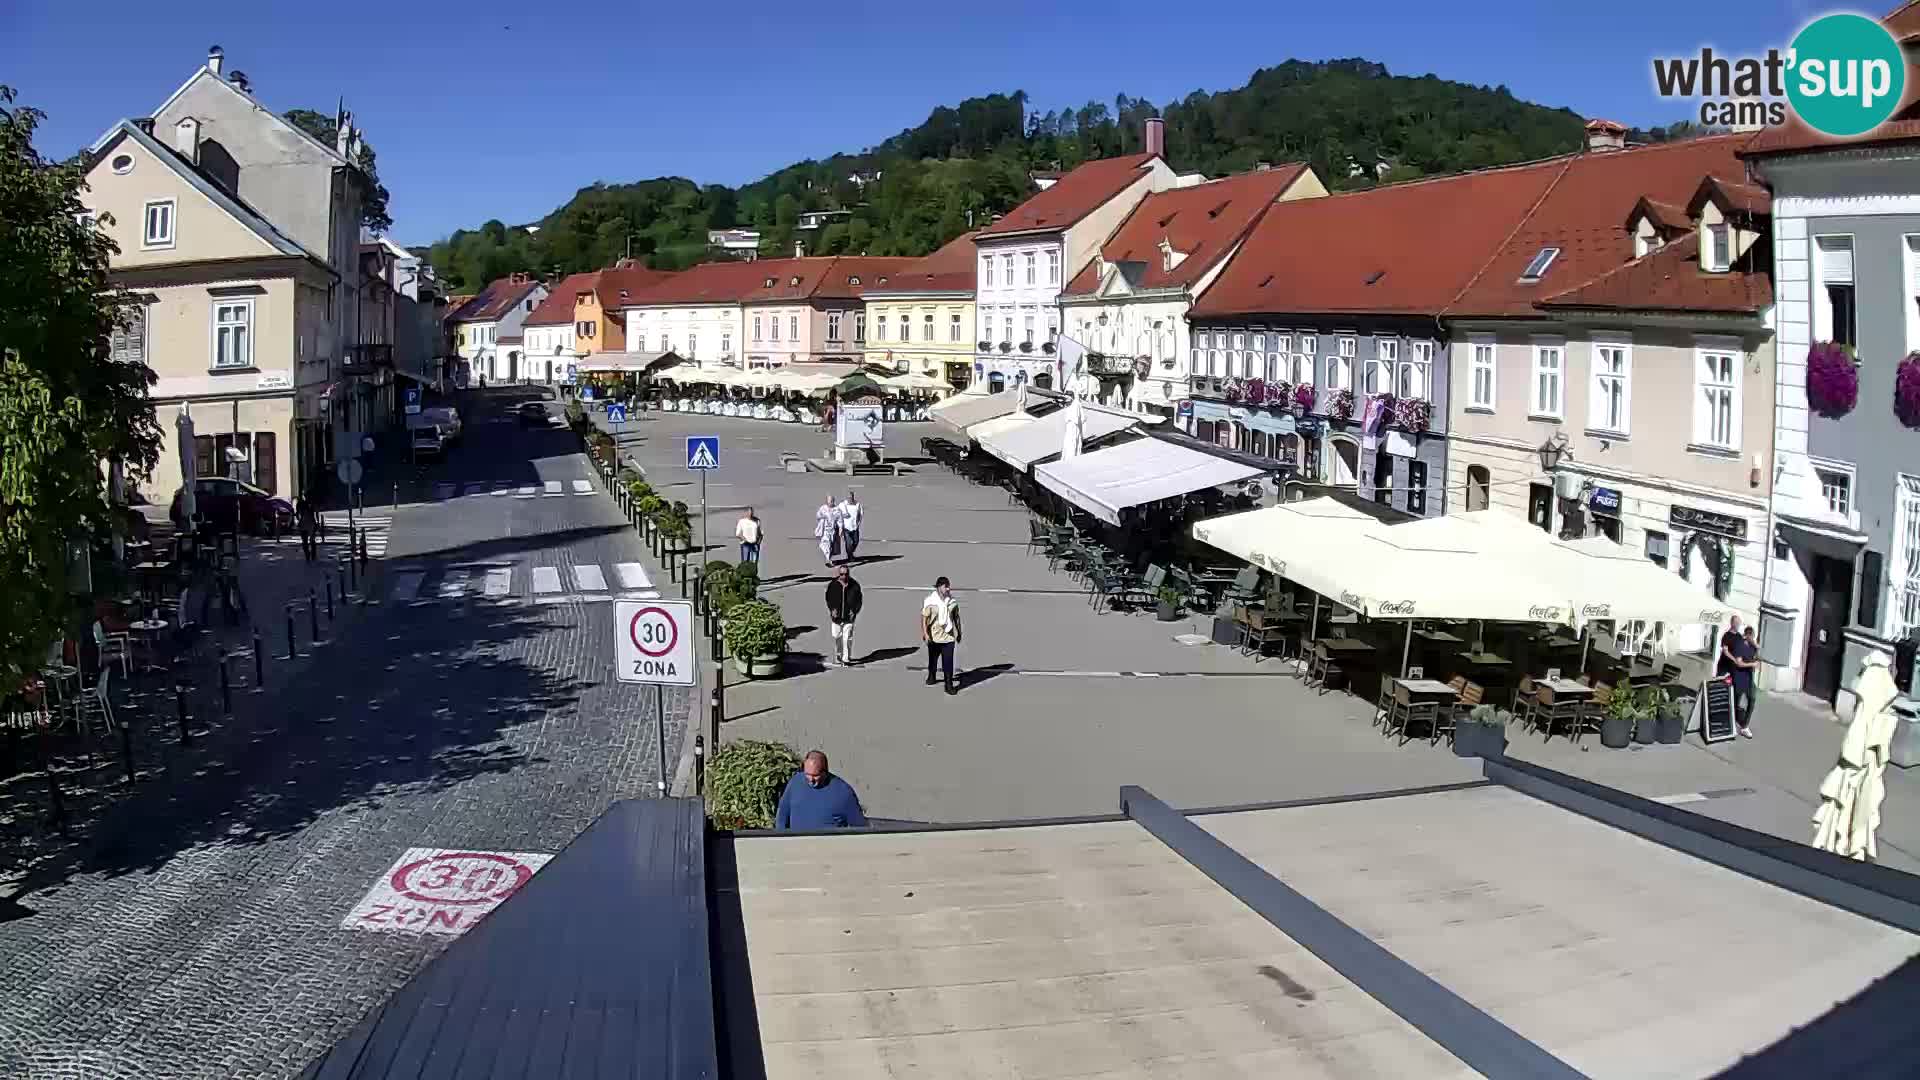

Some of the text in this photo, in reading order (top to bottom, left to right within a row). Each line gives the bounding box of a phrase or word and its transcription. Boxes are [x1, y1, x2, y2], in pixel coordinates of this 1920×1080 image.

[408, 391, 417, 402] P
[642, 622, 667, 644] 30
[632, 660, 677, 676] ZONA
[419, 864, 504, 893] 30
